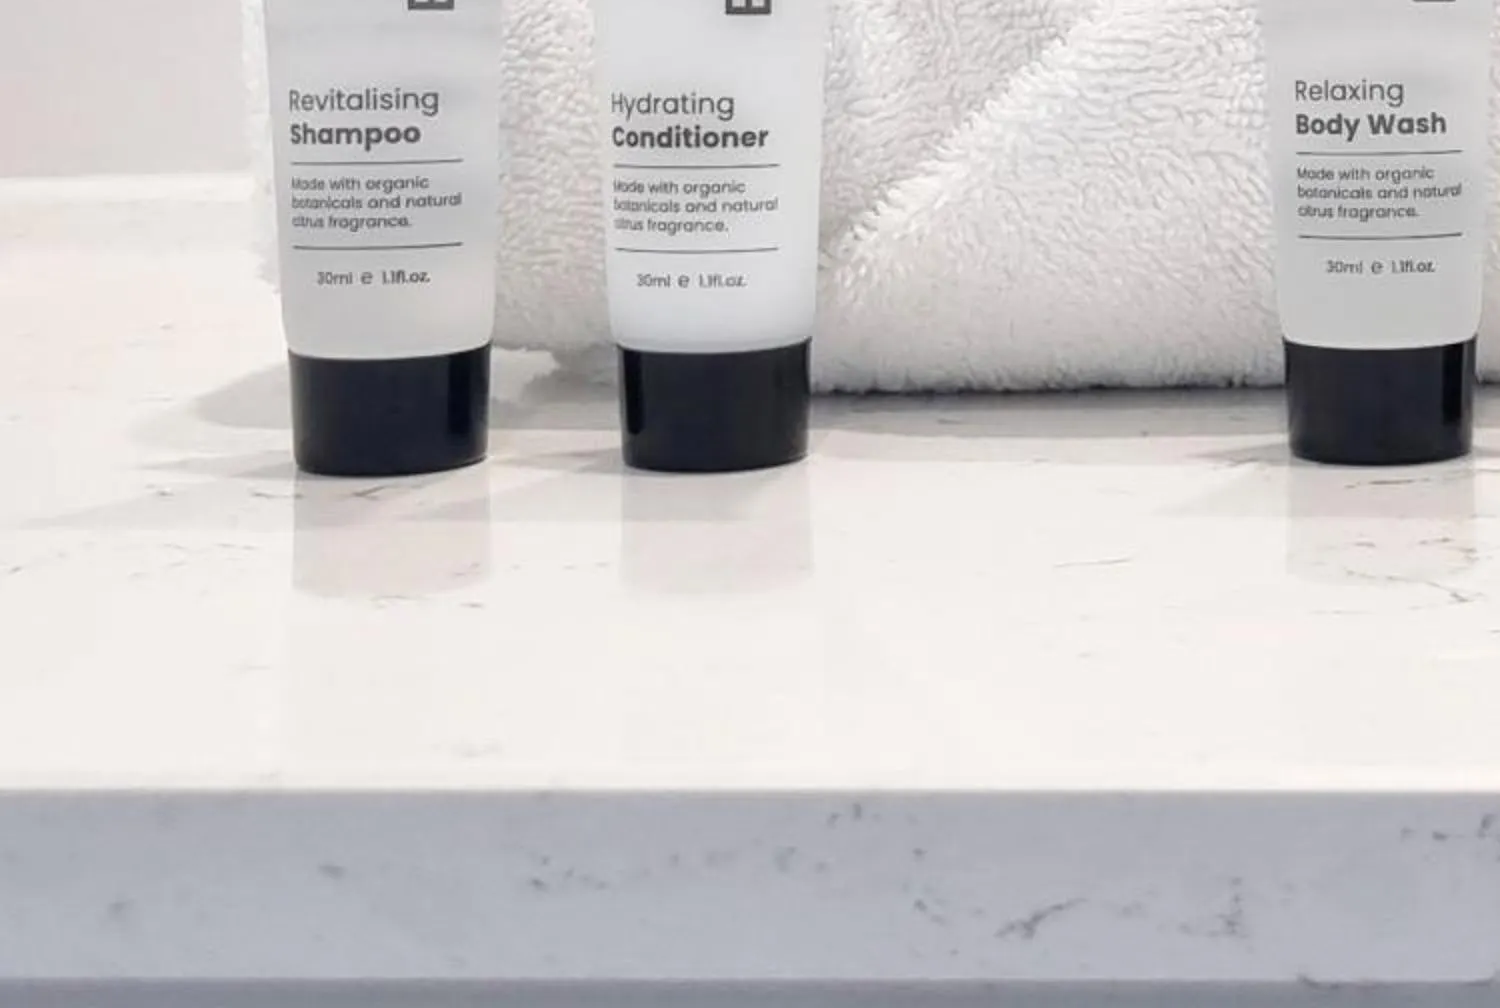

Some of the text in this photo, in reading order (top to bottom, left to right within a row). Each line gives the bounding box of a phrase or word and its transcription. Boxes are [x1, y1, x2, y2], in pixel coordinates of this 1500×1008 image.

[289, 88, 439, 116] Revitalising
[1295, 79, 1404, 107] Relaxing
[611, 92, 734, 121] Hydrating
[612, 125, 769, 148] Conditioner
[1296, 112, 1446, 141] Body Wash
[290, 123, 421, 151] Shampoo
[329, 177, 360, 190] with
[365, 176, 429, 193] organic
[1338, 167, 1370, 180] with
[1375, 166, 1434, 183] organic
[648, 181, 678, 193] with
[683, 180, 745, 197] organic
[1297, 183, 1462, 200] botanicals and natural
[291, 193, 462, 209] botanicals and natural
[685, 199, 717, 213] and
[722, 198, 778, 212] natural
